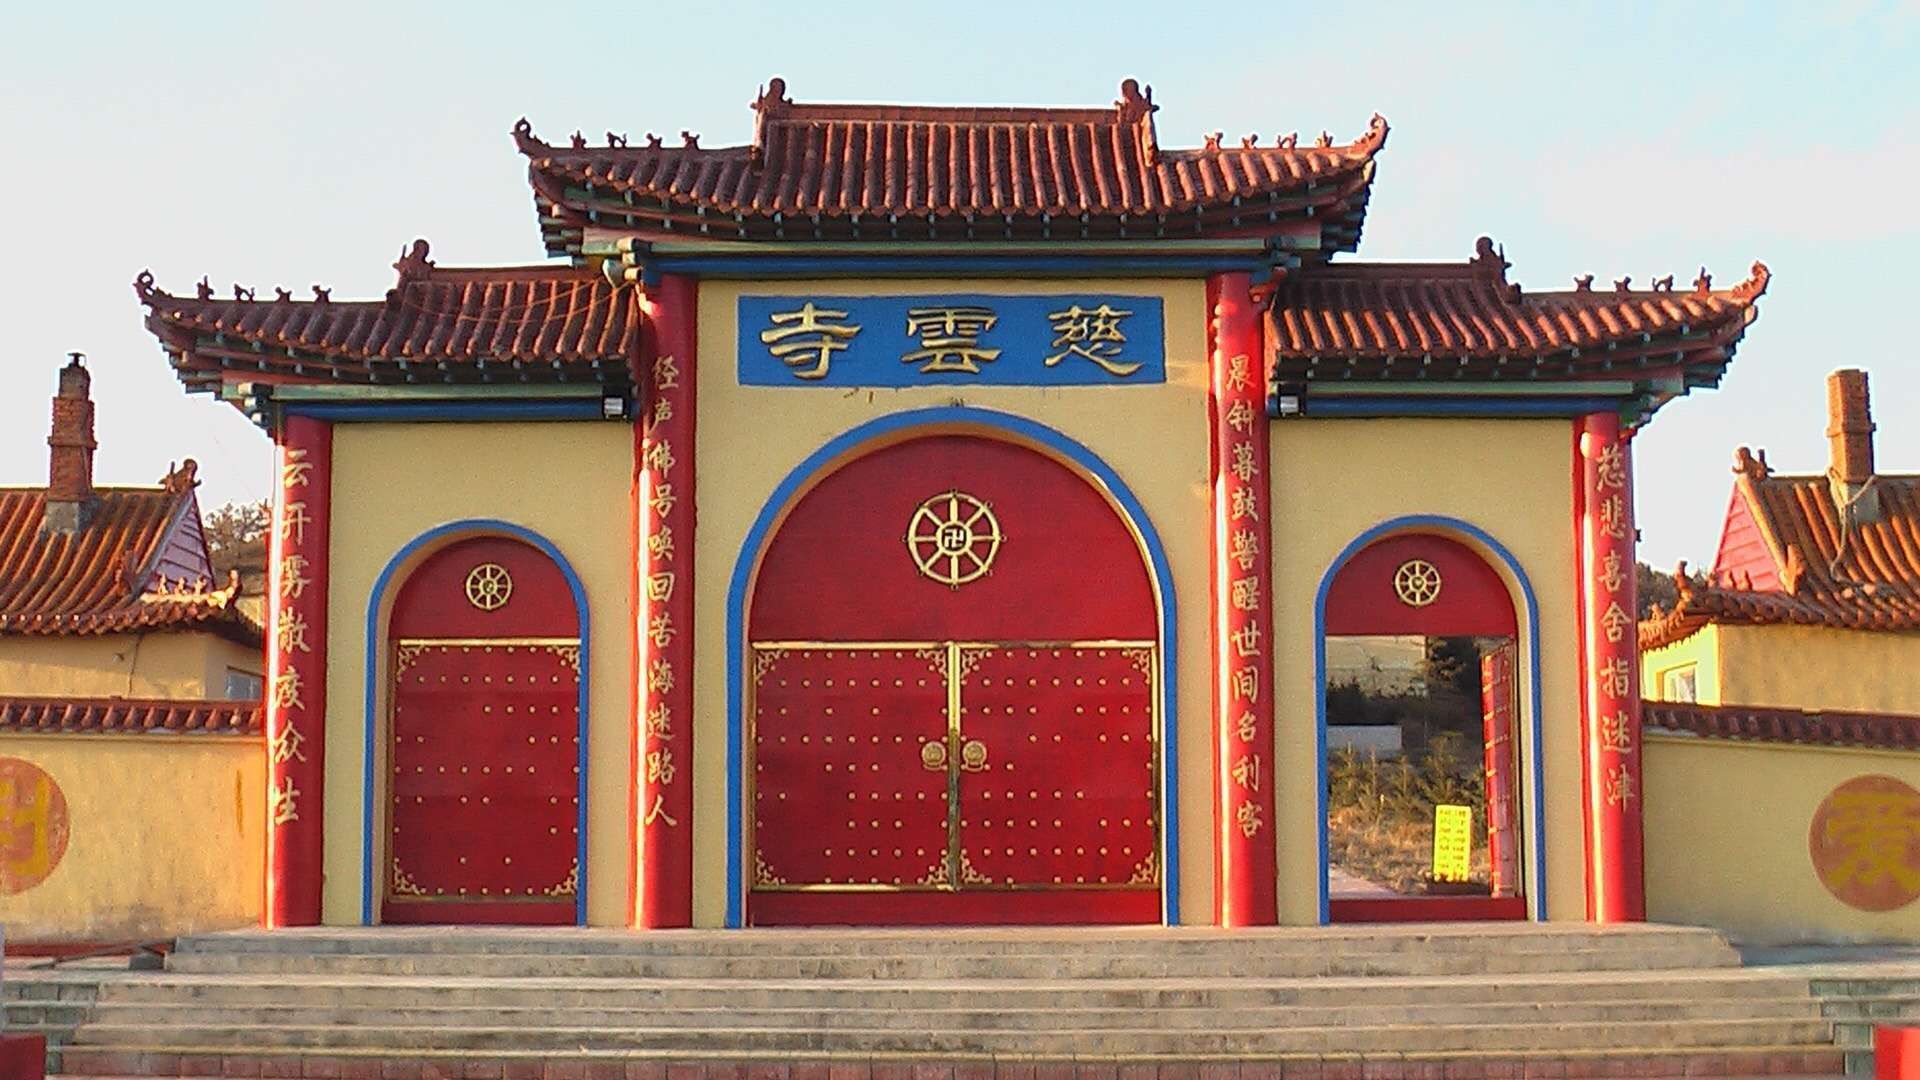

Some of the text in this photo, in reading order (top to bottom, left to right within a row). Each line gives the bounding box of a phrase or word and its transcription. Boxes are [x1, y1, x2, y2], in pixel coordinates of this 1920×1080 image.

[274, 448, 313, 826] 云开雾散度众生
[1595, 445, 1635, 813] 慈悲喜舍指迷津
